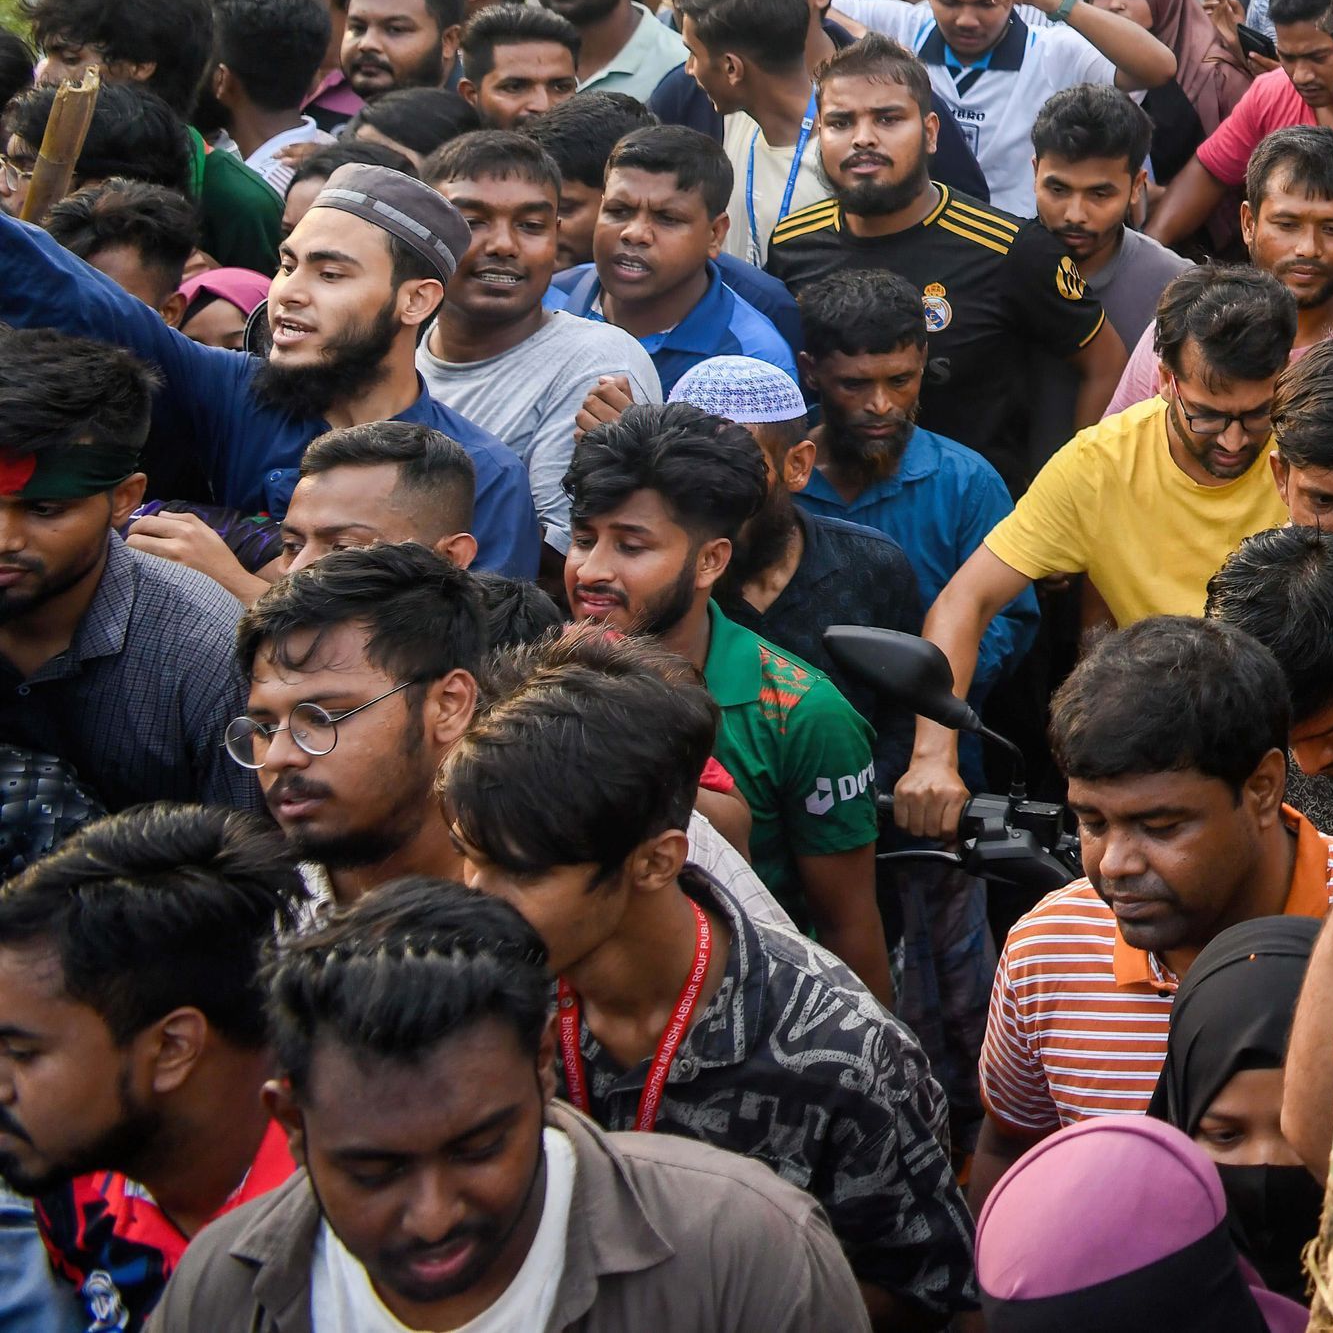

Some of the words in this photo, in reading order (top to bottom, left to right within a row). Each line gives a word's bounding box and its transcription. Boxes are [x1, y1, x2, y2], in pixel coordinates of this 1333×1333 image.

[698, 912, 710, 949] PUBLIC
[693, 952, 708, 982] ROUF
[676, 985, 699, 1022] ABDUR
[562, 1016, 580, 1093] BIRSHRESHTHA
[659, 1022, 682, 1065] MUNSHI
